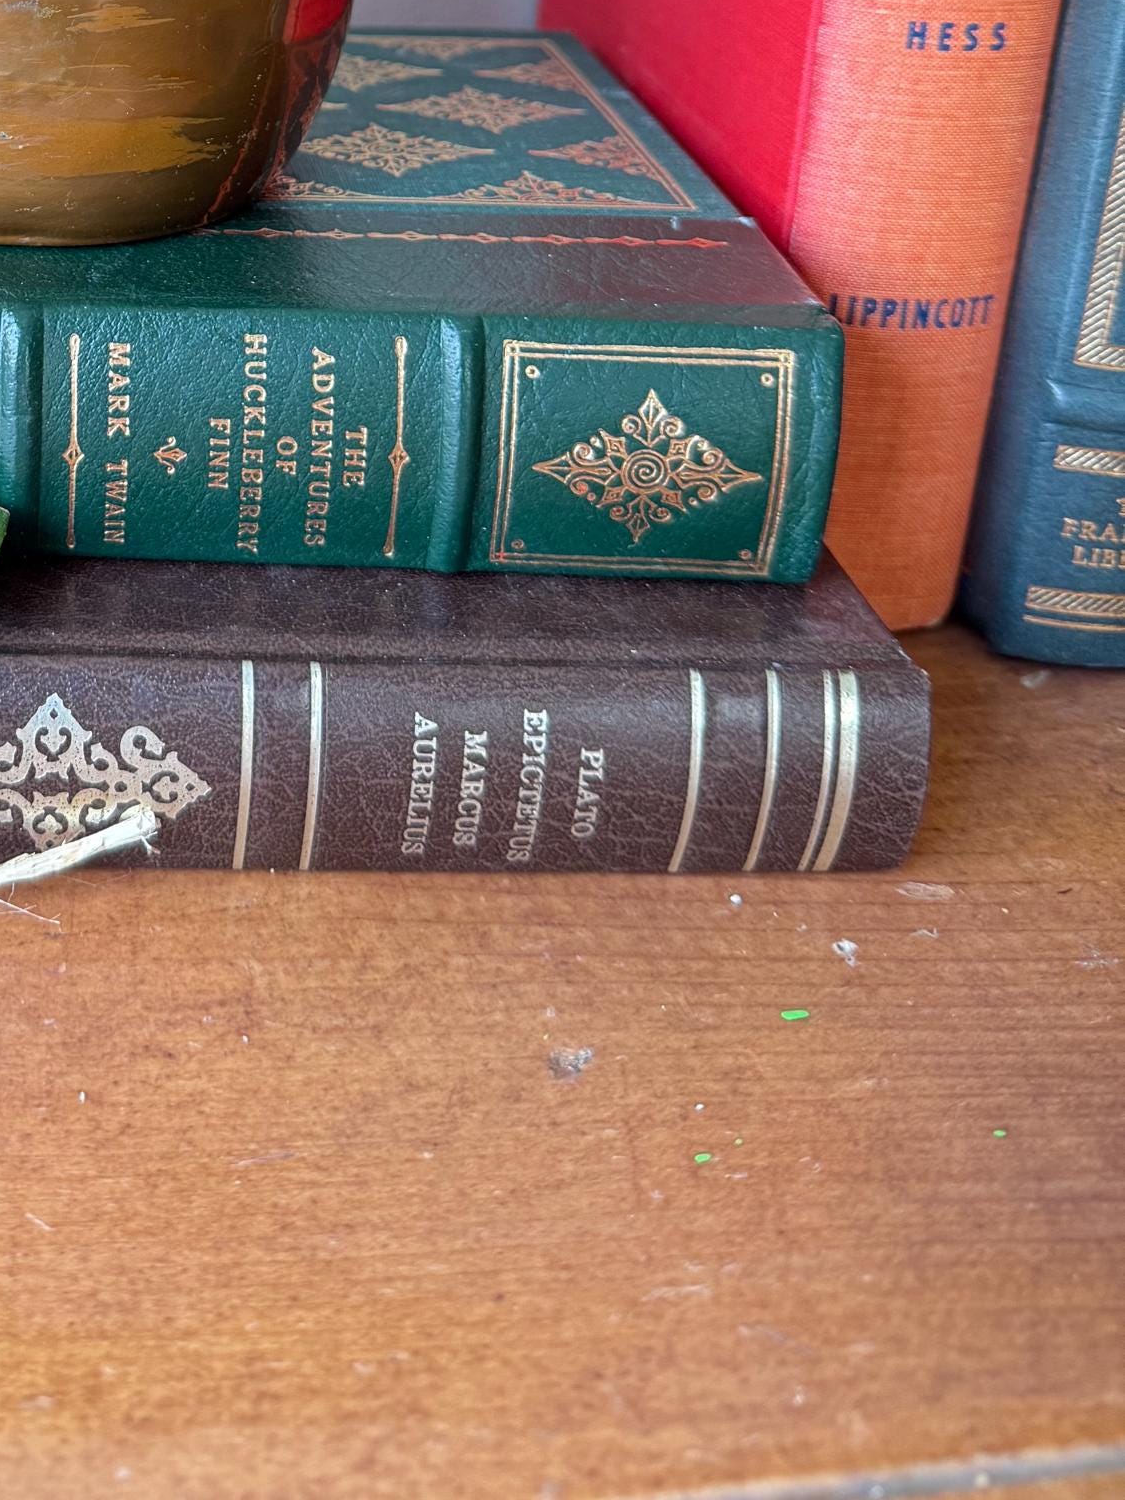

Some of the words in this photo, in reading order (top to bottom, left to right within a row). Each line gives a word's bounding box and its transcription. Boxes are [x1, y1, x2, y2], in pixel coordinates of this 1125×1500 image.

[905, 20, 1008, 52] HESS
[106, 342, 131, 437] MARK
[208, 418, 231, 490] FINN
[236, 333, 268, 554] HUCKLEBERRY
[276, 436, 298, 476] OF
[303, 346, 336, 547] ADVENTURES
[342, 425, 368, 487] THE
[103, 459, 129, 544] TWAIN
[401, 711, 438, 855] AURELIUS
[452, 730, 488, 846] MARCUS
[506, 708, 548, 862] EPICTETUS
[571, 748, 604, 838] PLATO
